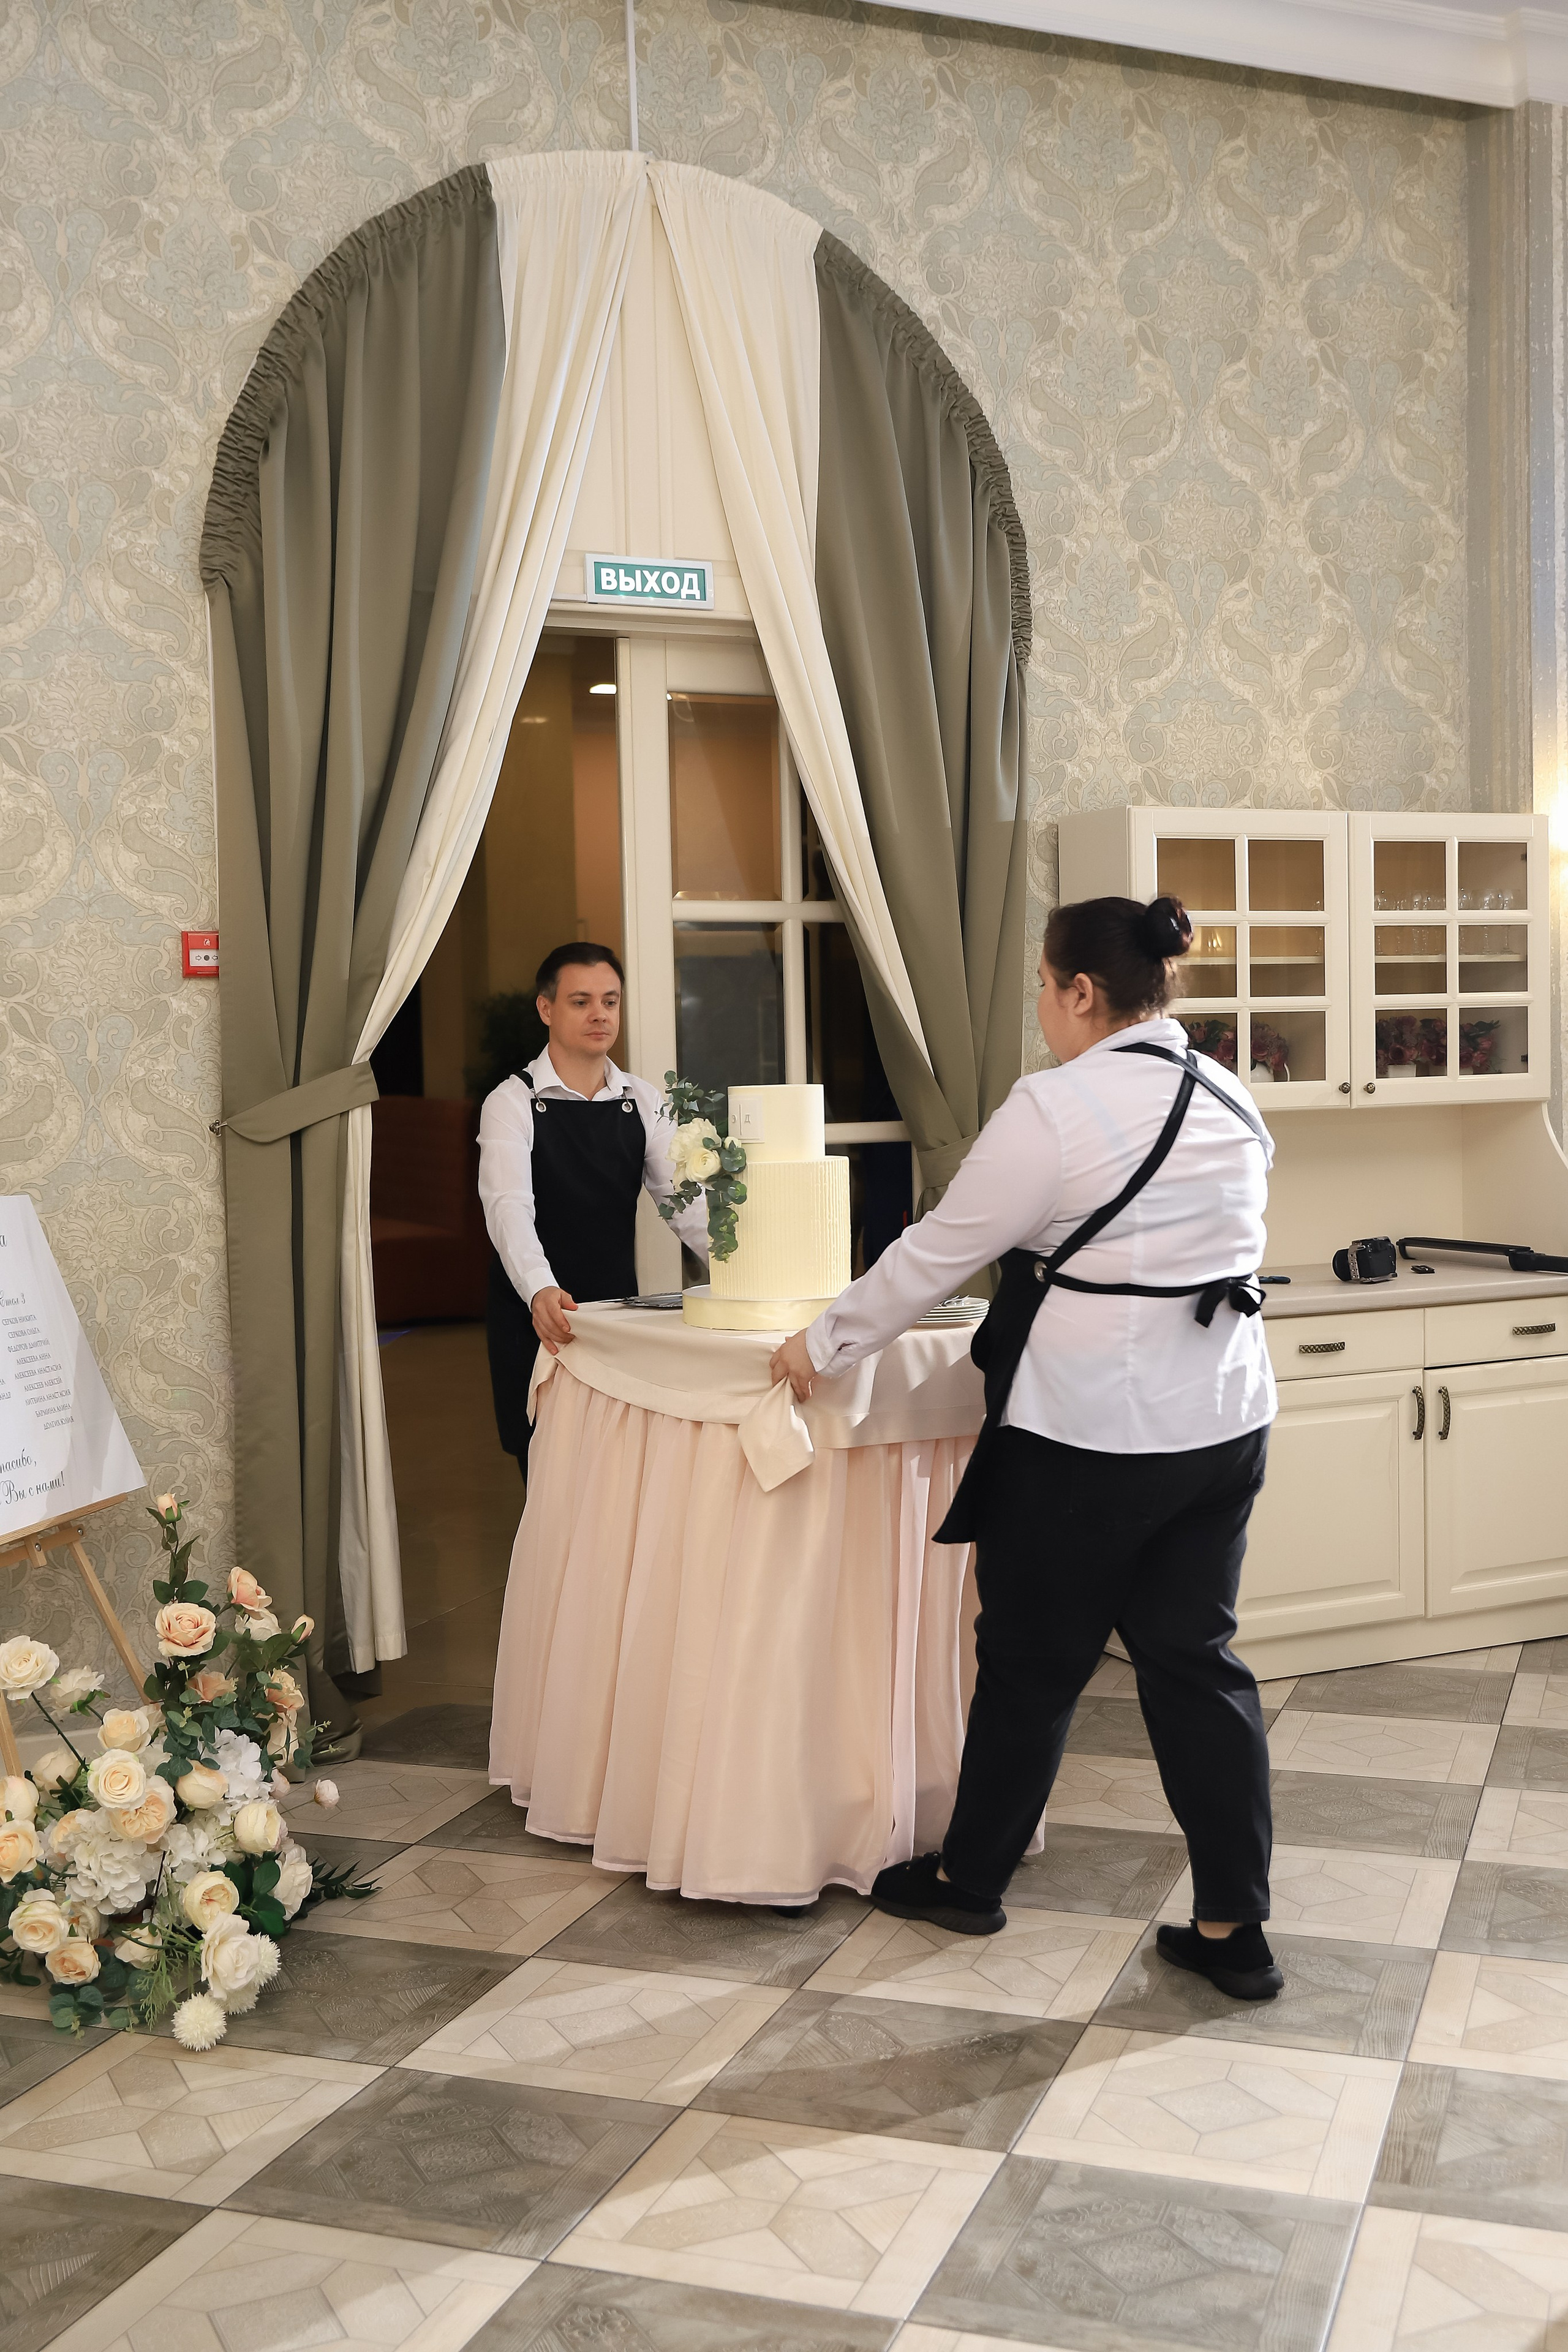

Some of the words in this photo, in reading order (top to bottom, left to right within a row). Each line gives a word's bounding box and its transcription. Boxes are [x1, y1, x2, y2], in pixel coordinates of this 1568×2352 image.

[600, 567, 701, 600] ВЫХОД
[744, 1114, 751, 1125] Д
[18, 1314, 37, 1323] НИКИТА
[28, 1338, 50, 1349] ДМИТРИЙ
[17, 1355, 38, 1365] АЛЕКСЕЕВА
[39, 1352, 51, 1361] АННА
[15, 1370, 37, 1380] АЛЕКСЕЕВА
[37, 1363, 62, 1375] АНАСТАСИЯ
[24, 1381, 44, 1392] АЛЕКСЕЕВ
[44, 1376, 62, 1387] АЛЕКСЕЙ
[46, 1389, 71, 1400] АНАСТАСИЯ
[56, 1403, 72, 1412] АЛИНА
[28, 1487, 34, 1496] с
[36, 1471, 64, 1494] нами!
